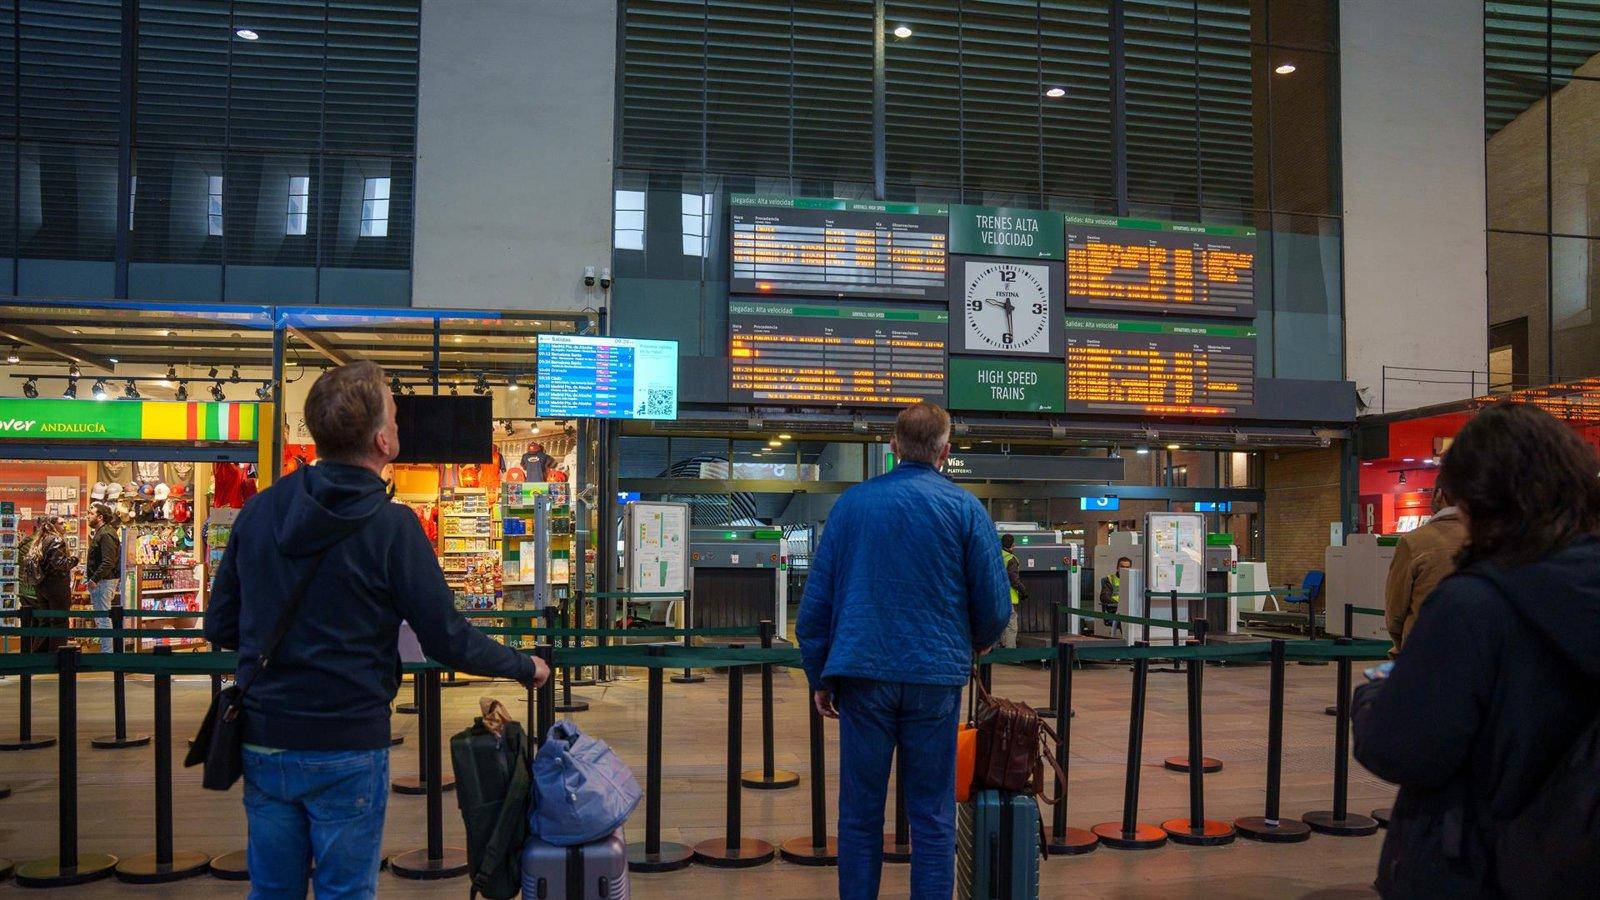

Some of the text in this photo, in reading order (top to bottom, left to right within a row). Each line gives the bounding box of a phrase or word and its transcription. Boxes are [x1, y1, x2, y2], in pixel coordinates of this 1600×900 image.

[976, 215, 1039, 232] TRENES ALTA
[981, 231, 1034, 247] VELOCIDAD
[999, 271, 1016, 283] 12
[731, 305, 793, 315] Llegadas: Alta velocidad
[972, 300, 983, 312] 9
[1032, 303, 1043, 315] 3
[1065, 320, 1084, 328] Salidas:
[1002, 333, 1013, 344] 6
[978, 370, 1038, 385] HIGH SPEED
[990, 386, 1026, 400] TRAINS
[0, 418, 106, 433] ver ANDALUCÍA
[947, 457, 965, 467] Vías
